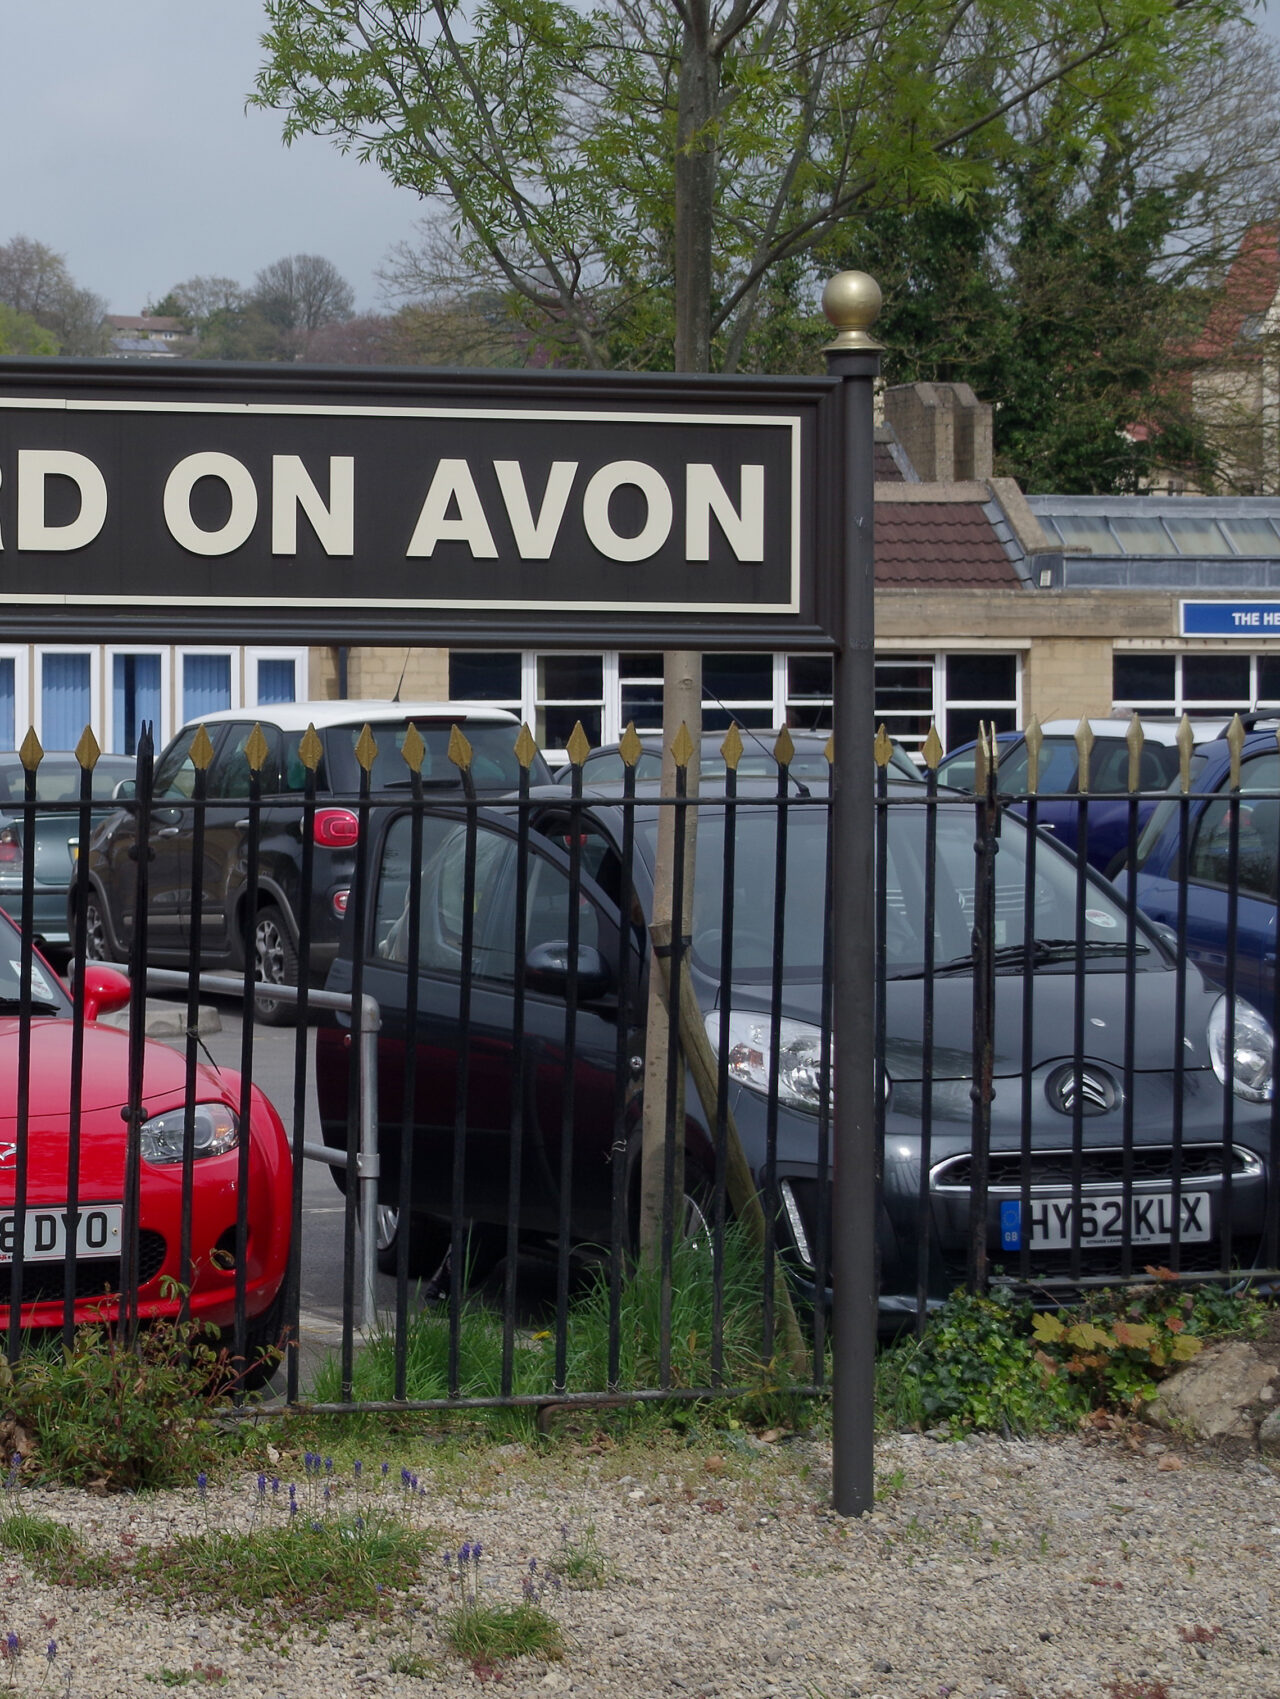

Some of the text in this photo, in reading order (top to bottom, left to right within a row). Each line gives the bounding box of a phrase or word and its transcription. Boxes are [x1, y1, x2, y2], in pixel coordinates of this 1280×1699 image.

[163, 451, 355, 557] ON
[405, 458, 765, 563] AVON
[1231, 612, 1260, 626] THE
[34, 1211, 108, 1252] DYO
[1004, 1231, 1018, 1242] GB
[1028, 1197, 1203, 1241] HY62 KLX
